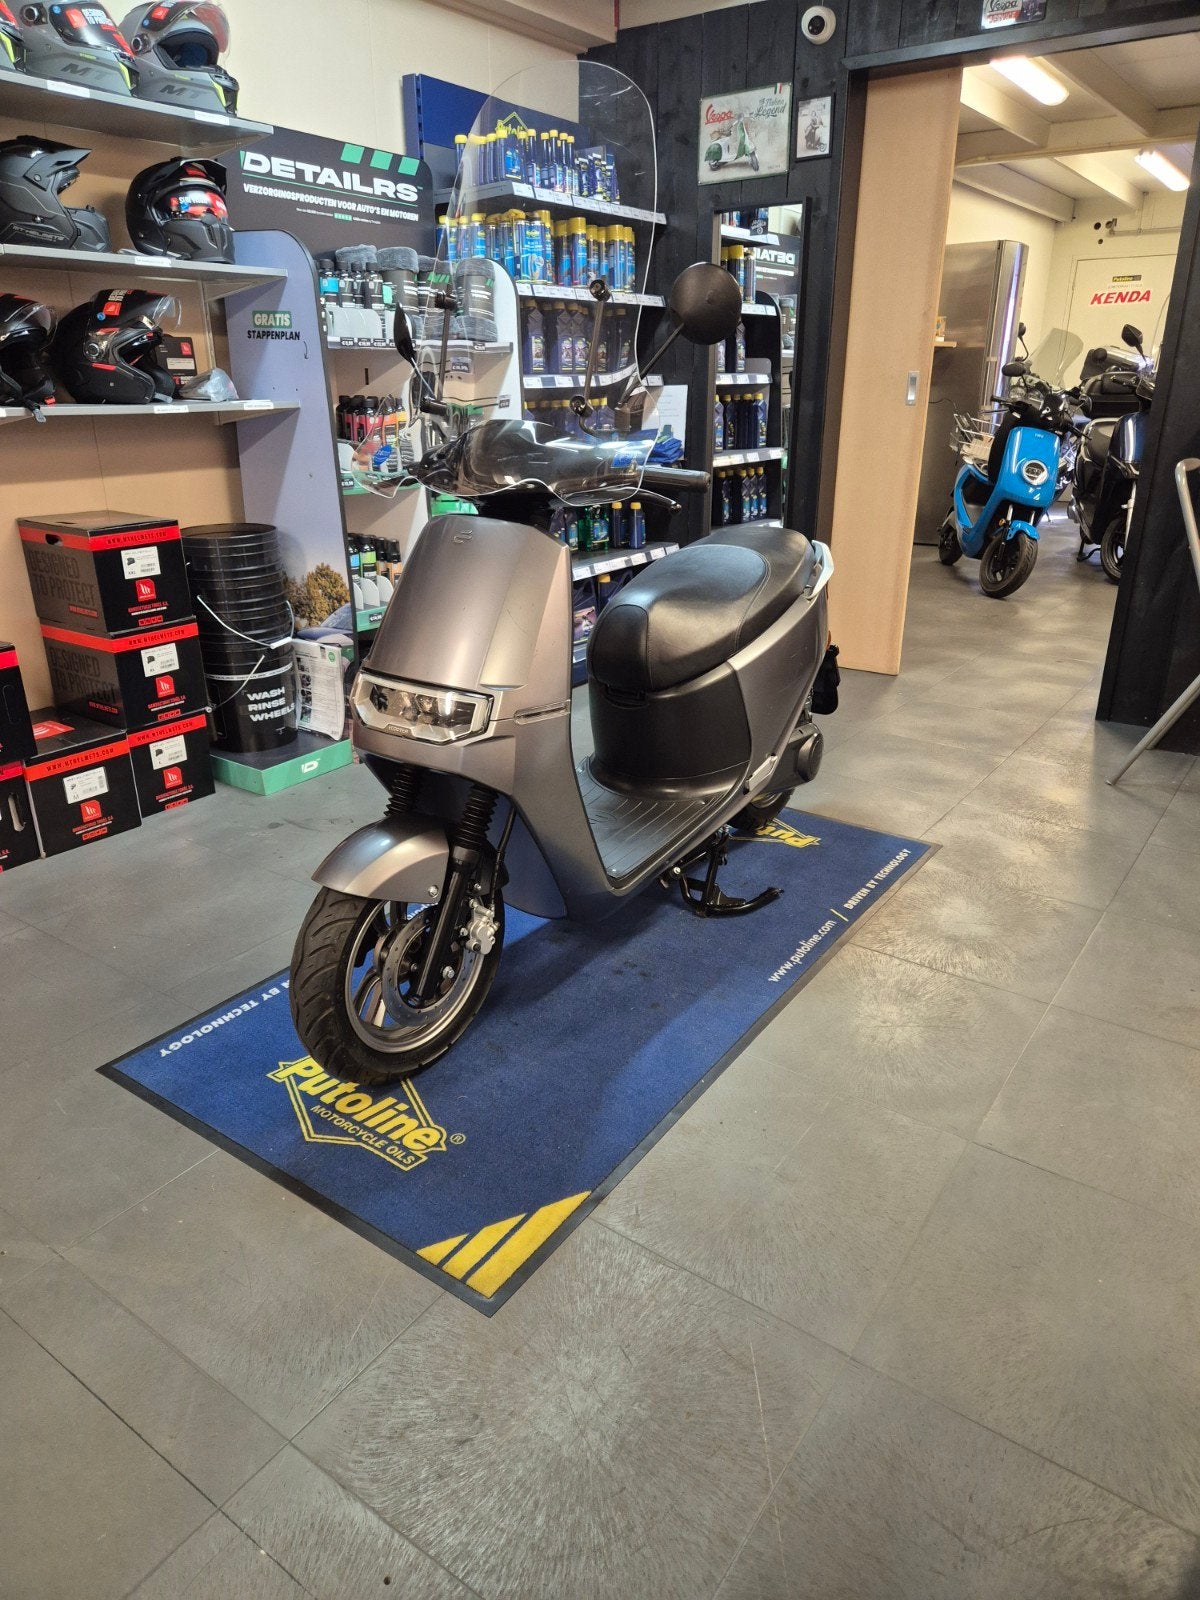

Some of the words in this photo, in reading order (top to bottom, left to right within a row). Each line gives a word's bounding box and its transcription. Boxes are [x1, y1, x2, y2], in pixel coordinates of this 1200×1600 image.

[61, 63, 108, 80] MT
[704, 103, 735, 125] Vespa
[243, 151, 418, 202] DETAILRS
[243, 183, 336, 208] VERZORGINGSPRODUCTEN
[337, 200, 357, 211] VOOR
[357, 203, 381, 215] AUTO'S
[381, 208, 389, 217] EN
[389, 209, 419, 221] MOTOREN
[1090, 290, 1151, 305] KENDA
[254, 313, 291, 326] GRATIS
[247, 330, 300, 341] STAPPENPLAN
[28, 551, 80, 580] DESIGNED
[50, 578, 97, 606] PROTECT
[247, 686, 286, 701] WASH
[248, 697, 286, 712] RINSE
[250, 703, 296, 722] WHEELS
[769, 919, 837, 983] www.putoline.com
[843, 887, 868, 910] DRIVEN
[866, 879, 878, 889] BY
[875, 848, 911, 881] TECHNOLOGY
[260, 987, 281, 1002] BY
[159, 999, 261, 1058] TECHNOLOGY
[273, 1056, 441, 1151] Putoline
[310, 1104, 388, 1149] MOTORCYCLE
[386, 1144, 417, 1165] OILS
